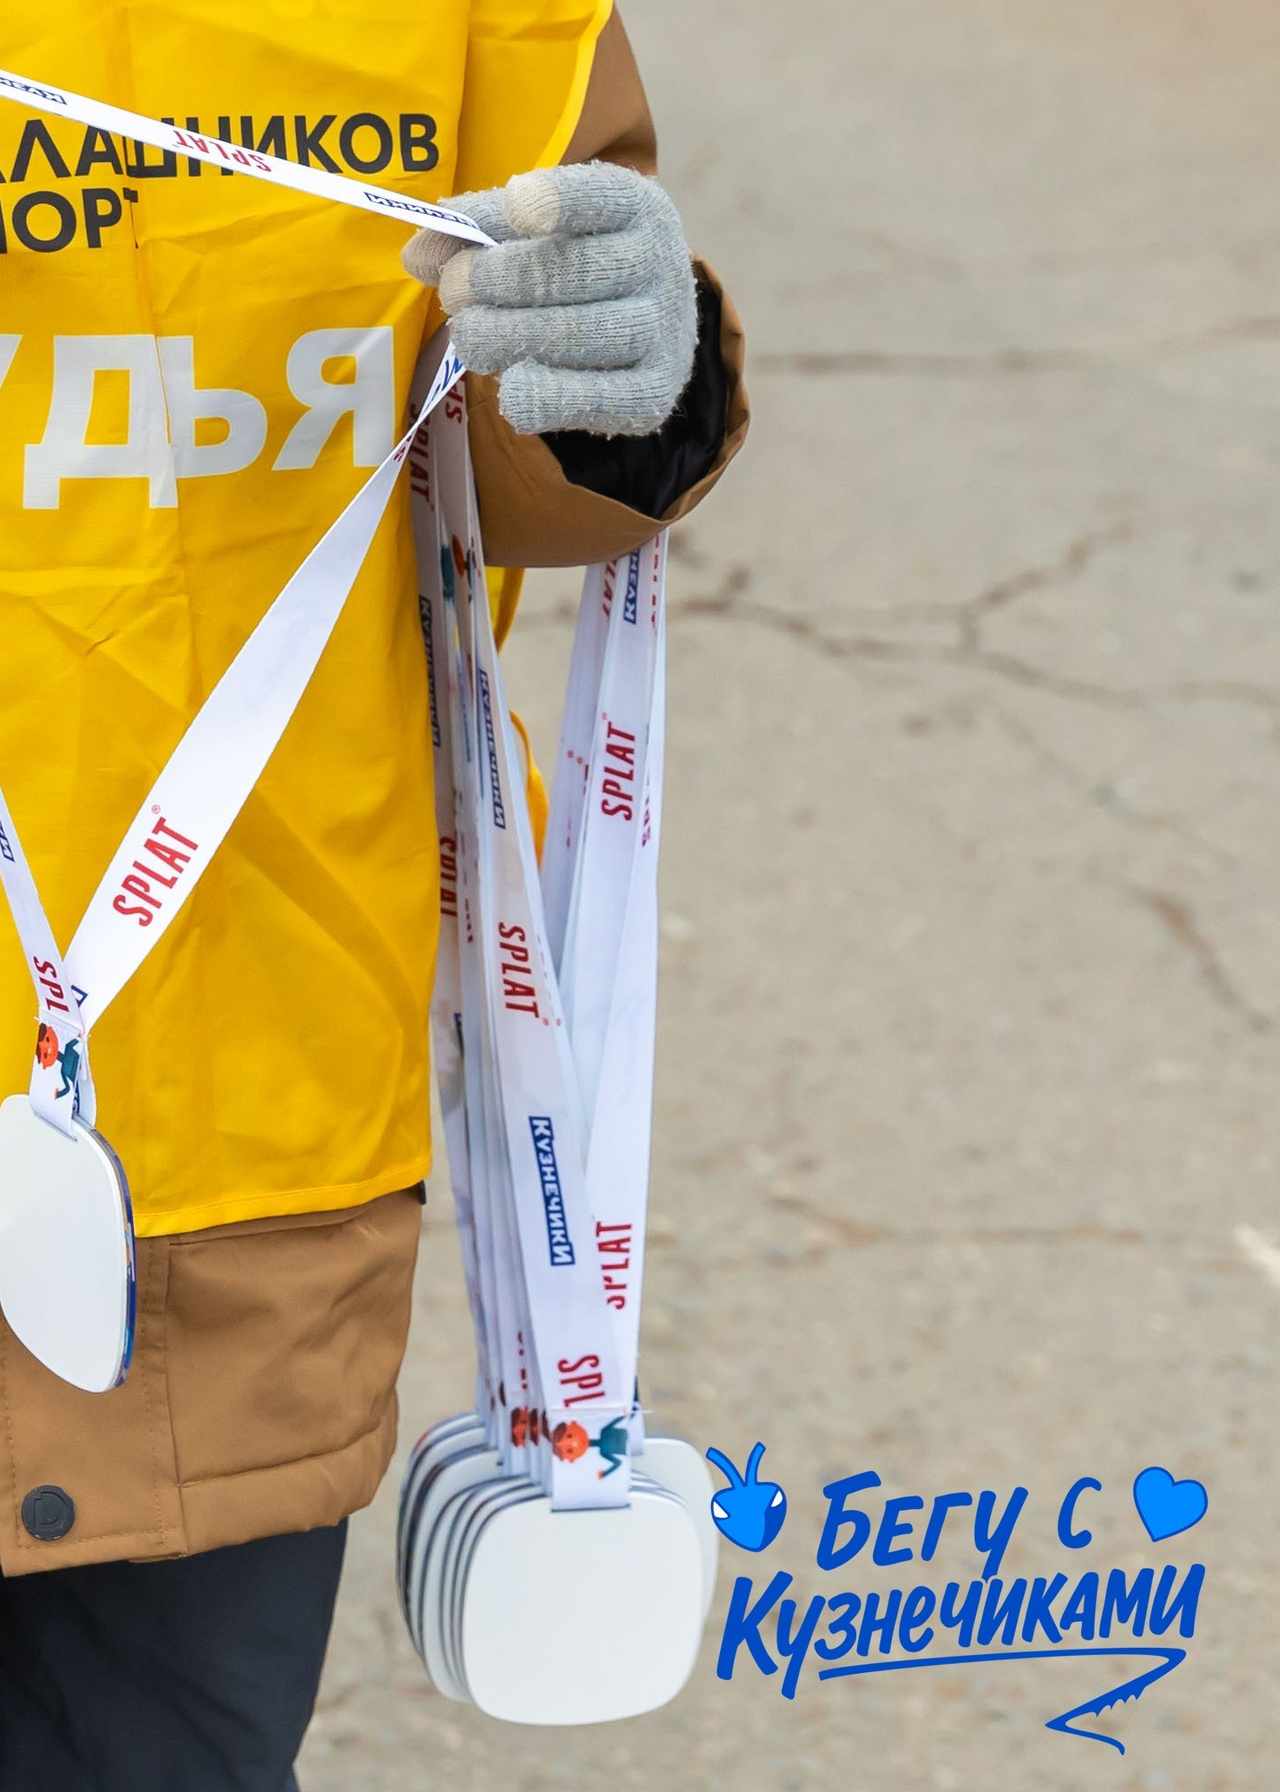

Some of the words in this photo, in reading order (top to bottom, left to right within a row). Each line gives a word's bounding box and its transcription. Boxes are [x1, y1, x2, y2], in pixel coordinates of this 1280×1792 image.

[172, 129, 272, 172] SPLAT
[601, 721, 636, 821] SPLAT
[111, 815, 199, 927] SPLAT
[33, 955, 71, 1013] SPL
[498, 921, 540, 1019] SPLAT
[528, 1115, 576, 1266] КУЗНЕЧИКИ
[557, 1354, 607, 1408] SPL
